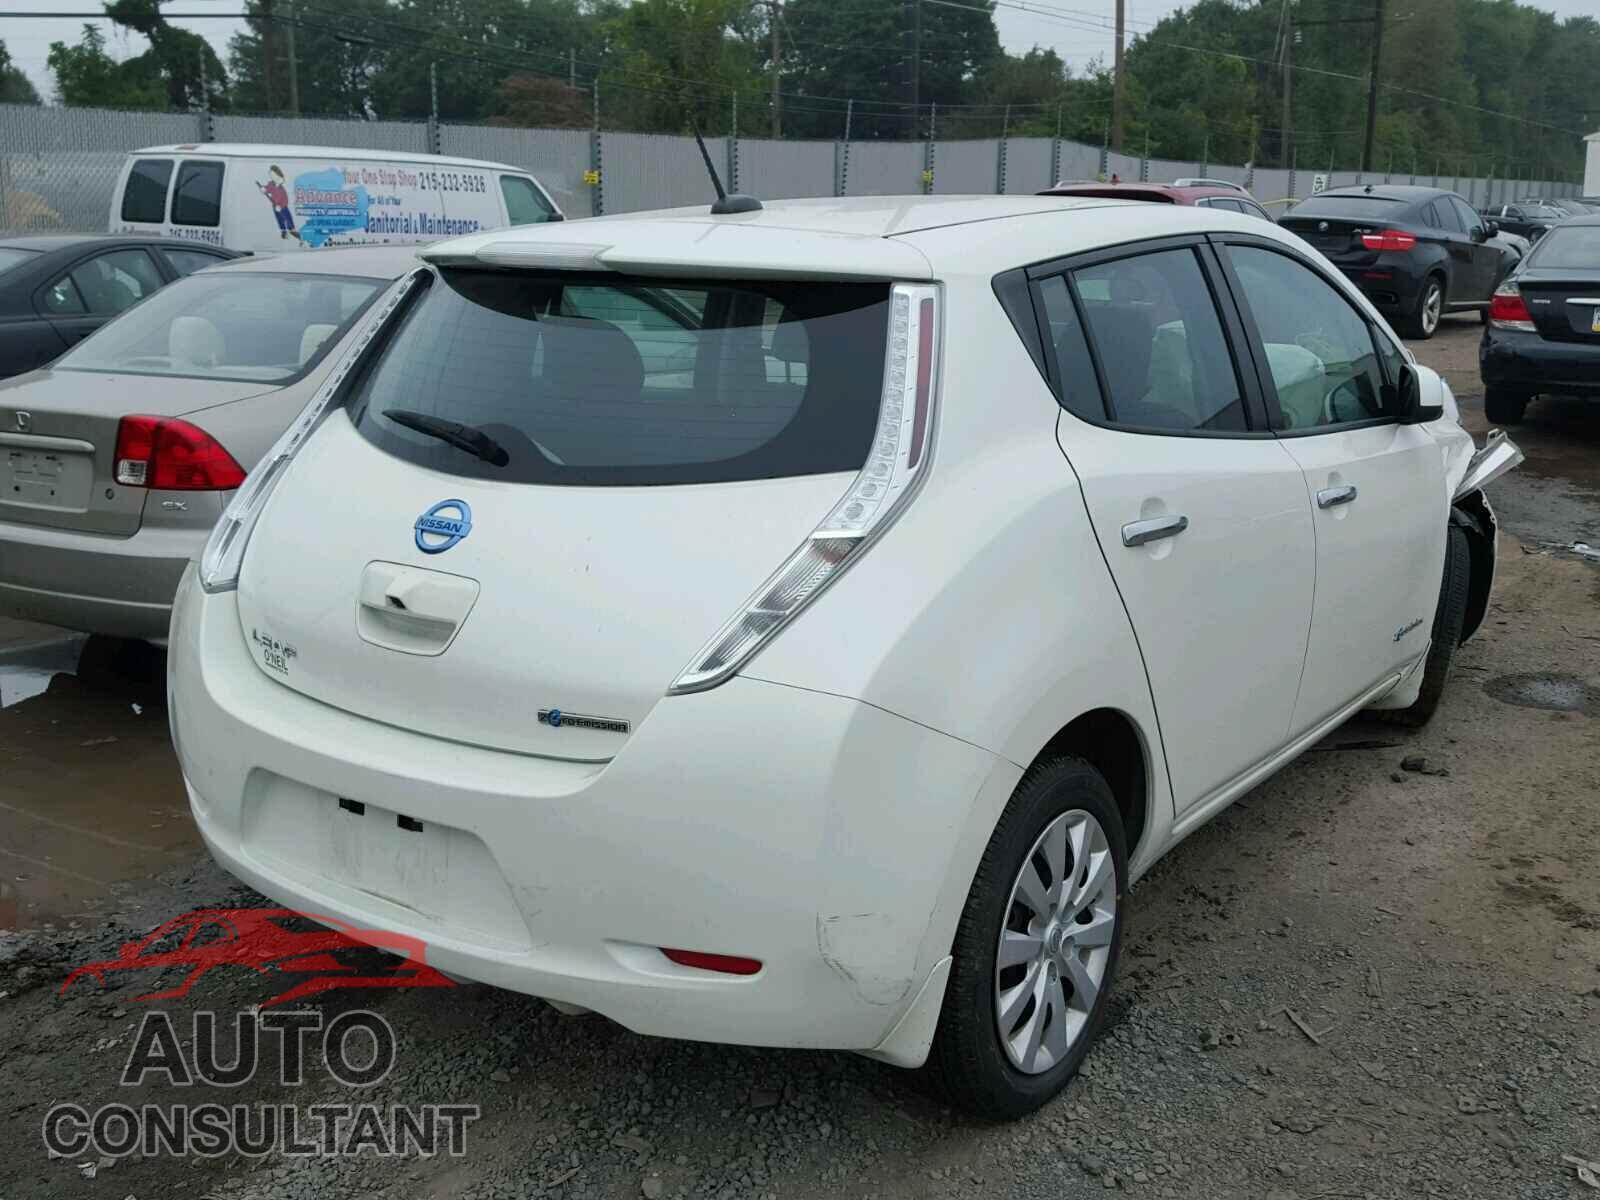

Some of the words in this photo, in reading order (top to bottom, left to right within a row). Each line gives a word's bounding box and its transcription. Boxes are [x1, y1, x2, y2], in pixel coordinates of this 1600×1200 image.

[362, 168, 378, 186] One
[379, 168, 397, 189] Stop
[398, 169, 417, 191] Shop
[418, 171, 486, 193] 215-232-5926
[365, 210, 412, 234] Janitorial
[419, 212, 479, 236] Maintenance
[420, 518, 463, 533] NISSAN
